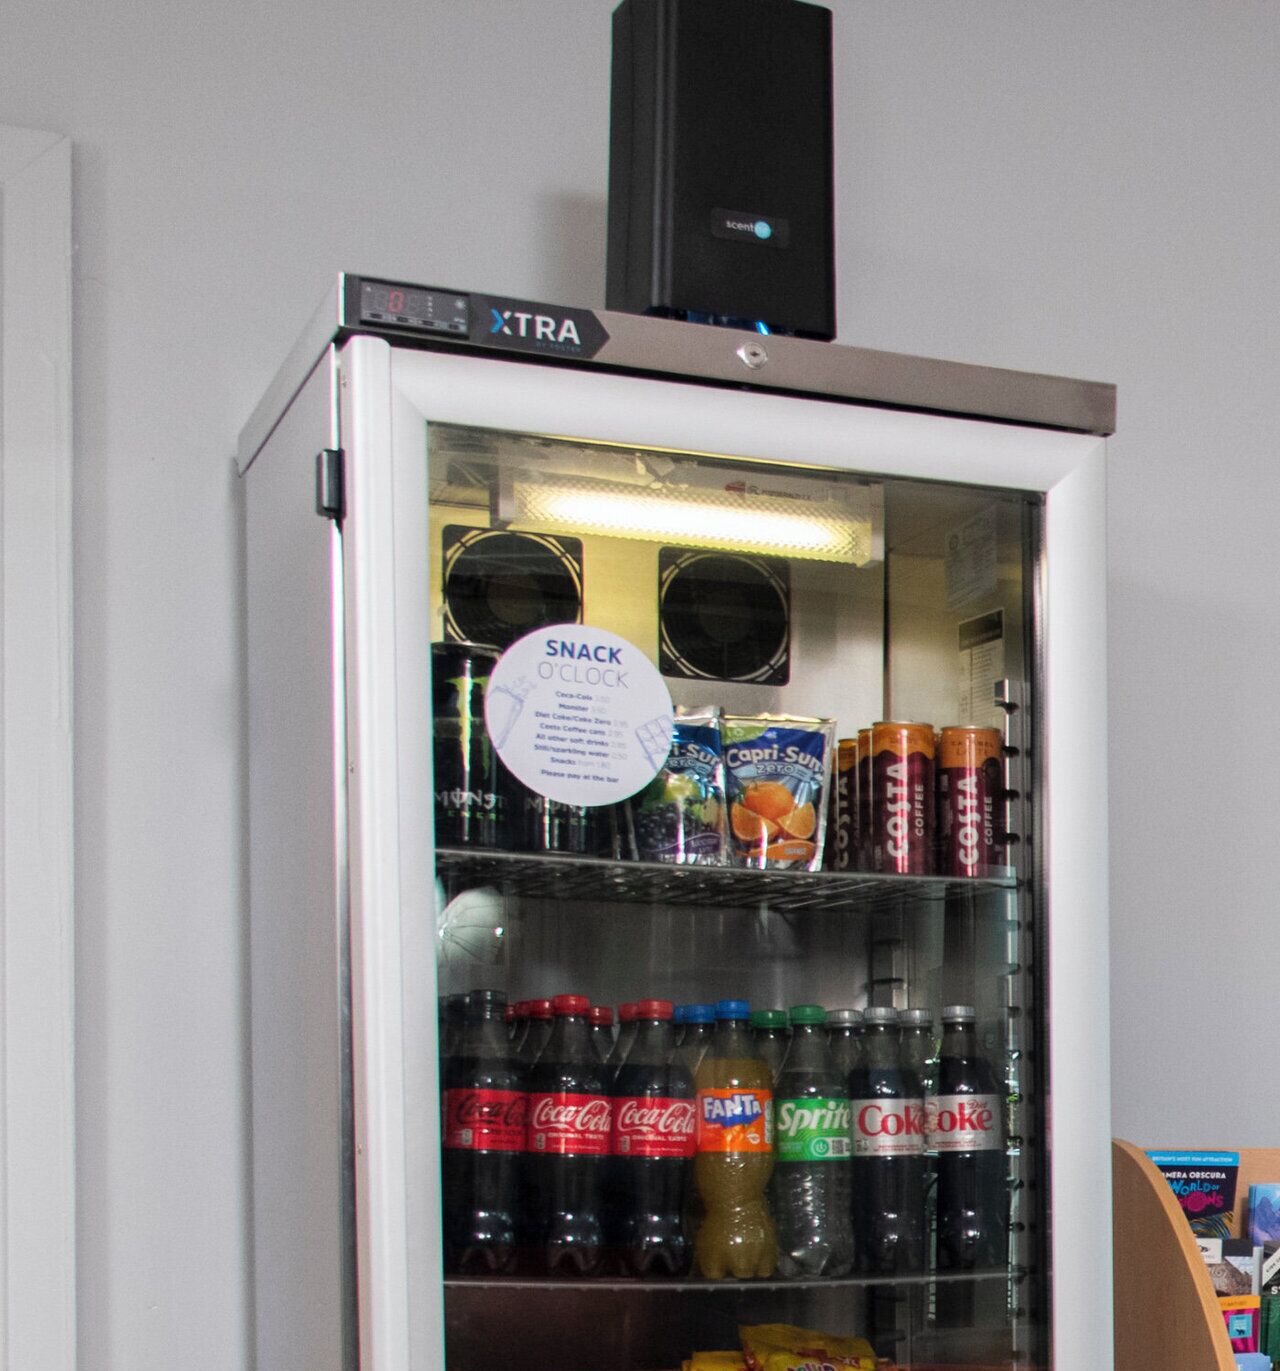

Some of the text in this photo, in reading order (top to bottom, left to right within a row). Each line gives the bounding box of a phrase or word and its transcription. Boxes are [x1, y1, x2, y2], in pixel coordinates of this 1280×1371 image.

[490, 308, 581, 345] XTRA
[546, 639, 622, 665] SNACK
[537, 660, 630, 688] O'CLOCK
[726, 744, 823, 771] Capri-Sun
[757, 762, 797, 774] zero
[886, 762, 912, 858] COSTA
[914, 784, 925, 837] COFFEE
[957, 775, 982, 866] COSTA
[984, 796, 994, 846] COFFEE
[703, 1093, 762, 1118] FANTA
[1189, 1171, 1226, 1179] OBSCURA
